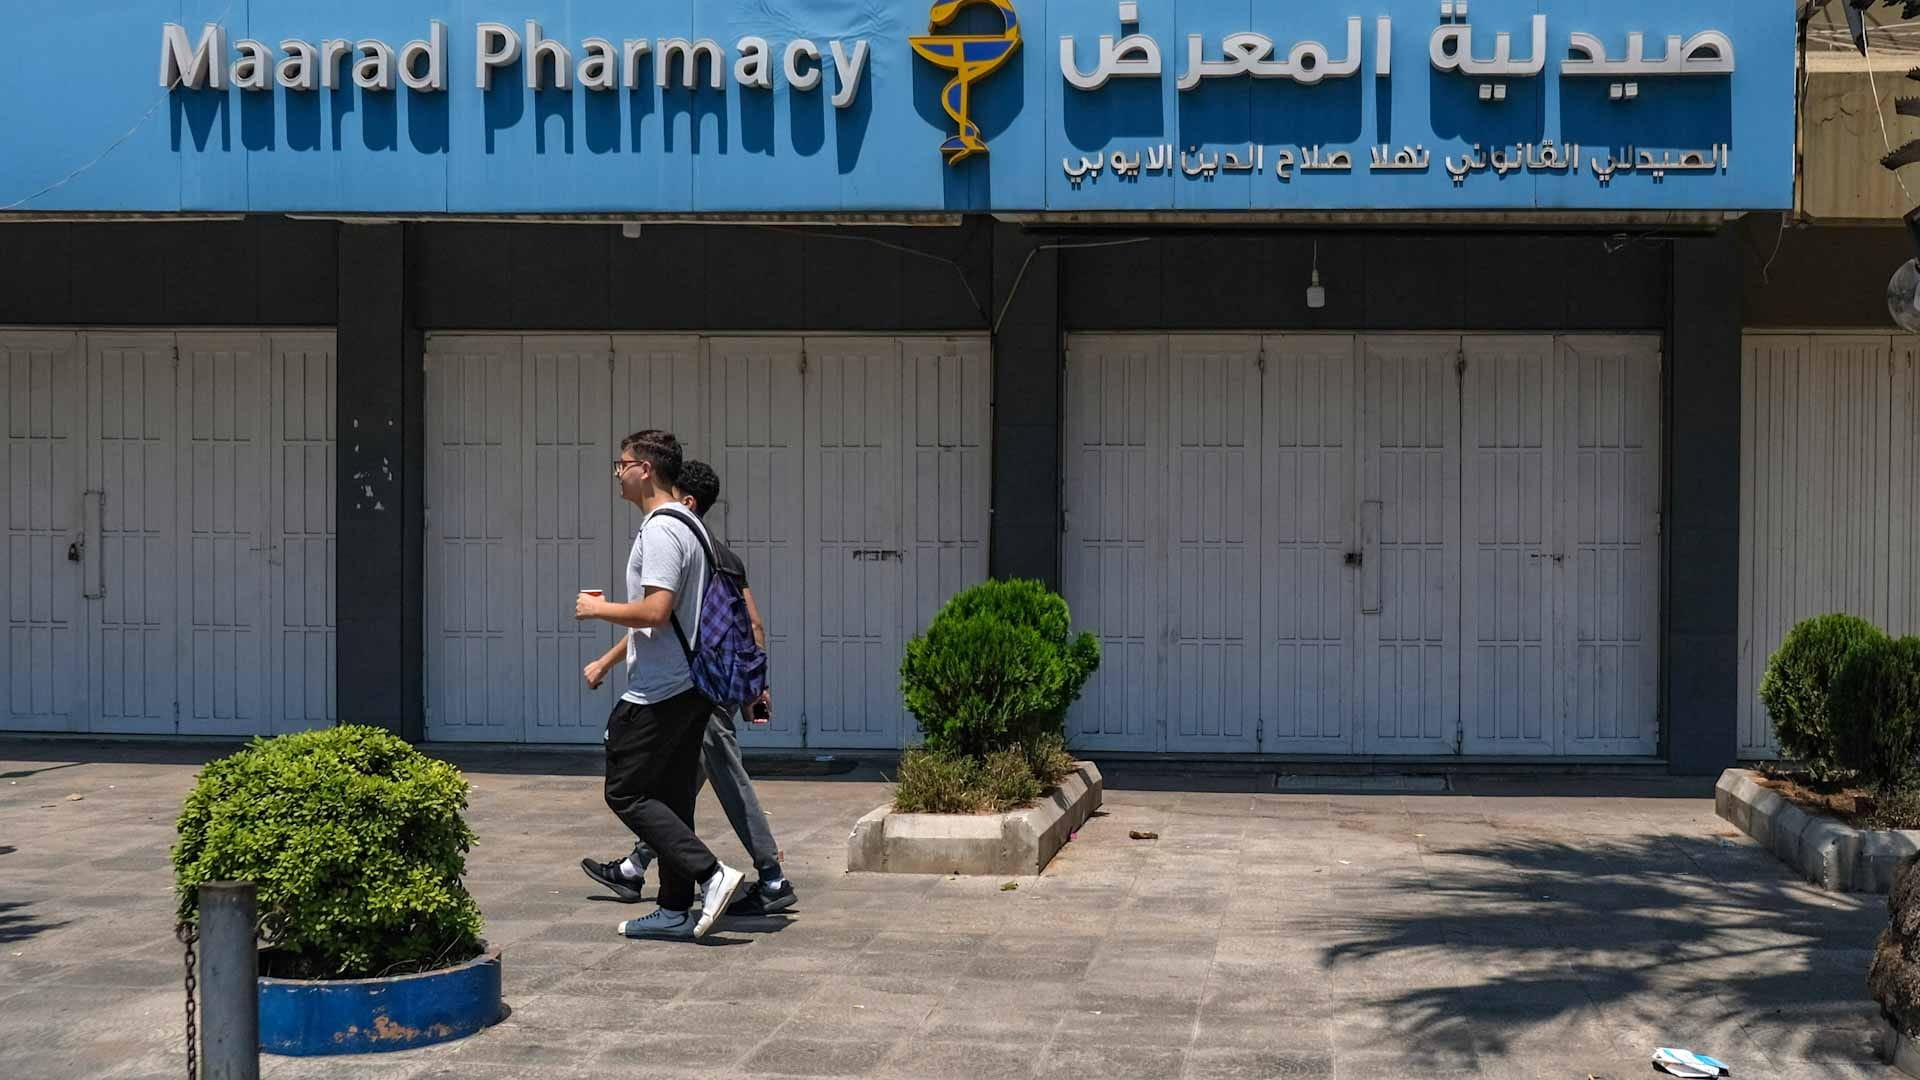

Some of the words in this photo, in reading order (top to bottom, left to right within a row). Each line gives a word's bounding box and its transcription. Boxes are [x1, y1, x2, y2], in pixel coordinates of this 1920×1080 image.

[158, 19, 449, 93] Maarad
[474, 19, 870, 109] Pharmacy
[1058, 1, 1393, 91] المعرض
[1429, 0, 1736, 101] صيدلية
[1062, 143, 1174, 184] الايوبي
[1181, 143, 1264, 177] الدين
[1275, 143, 1351, 179] صلاح
[1369, 143, 1430, 169] نهلا
[1445, 139, 1580, 182] القانوني
